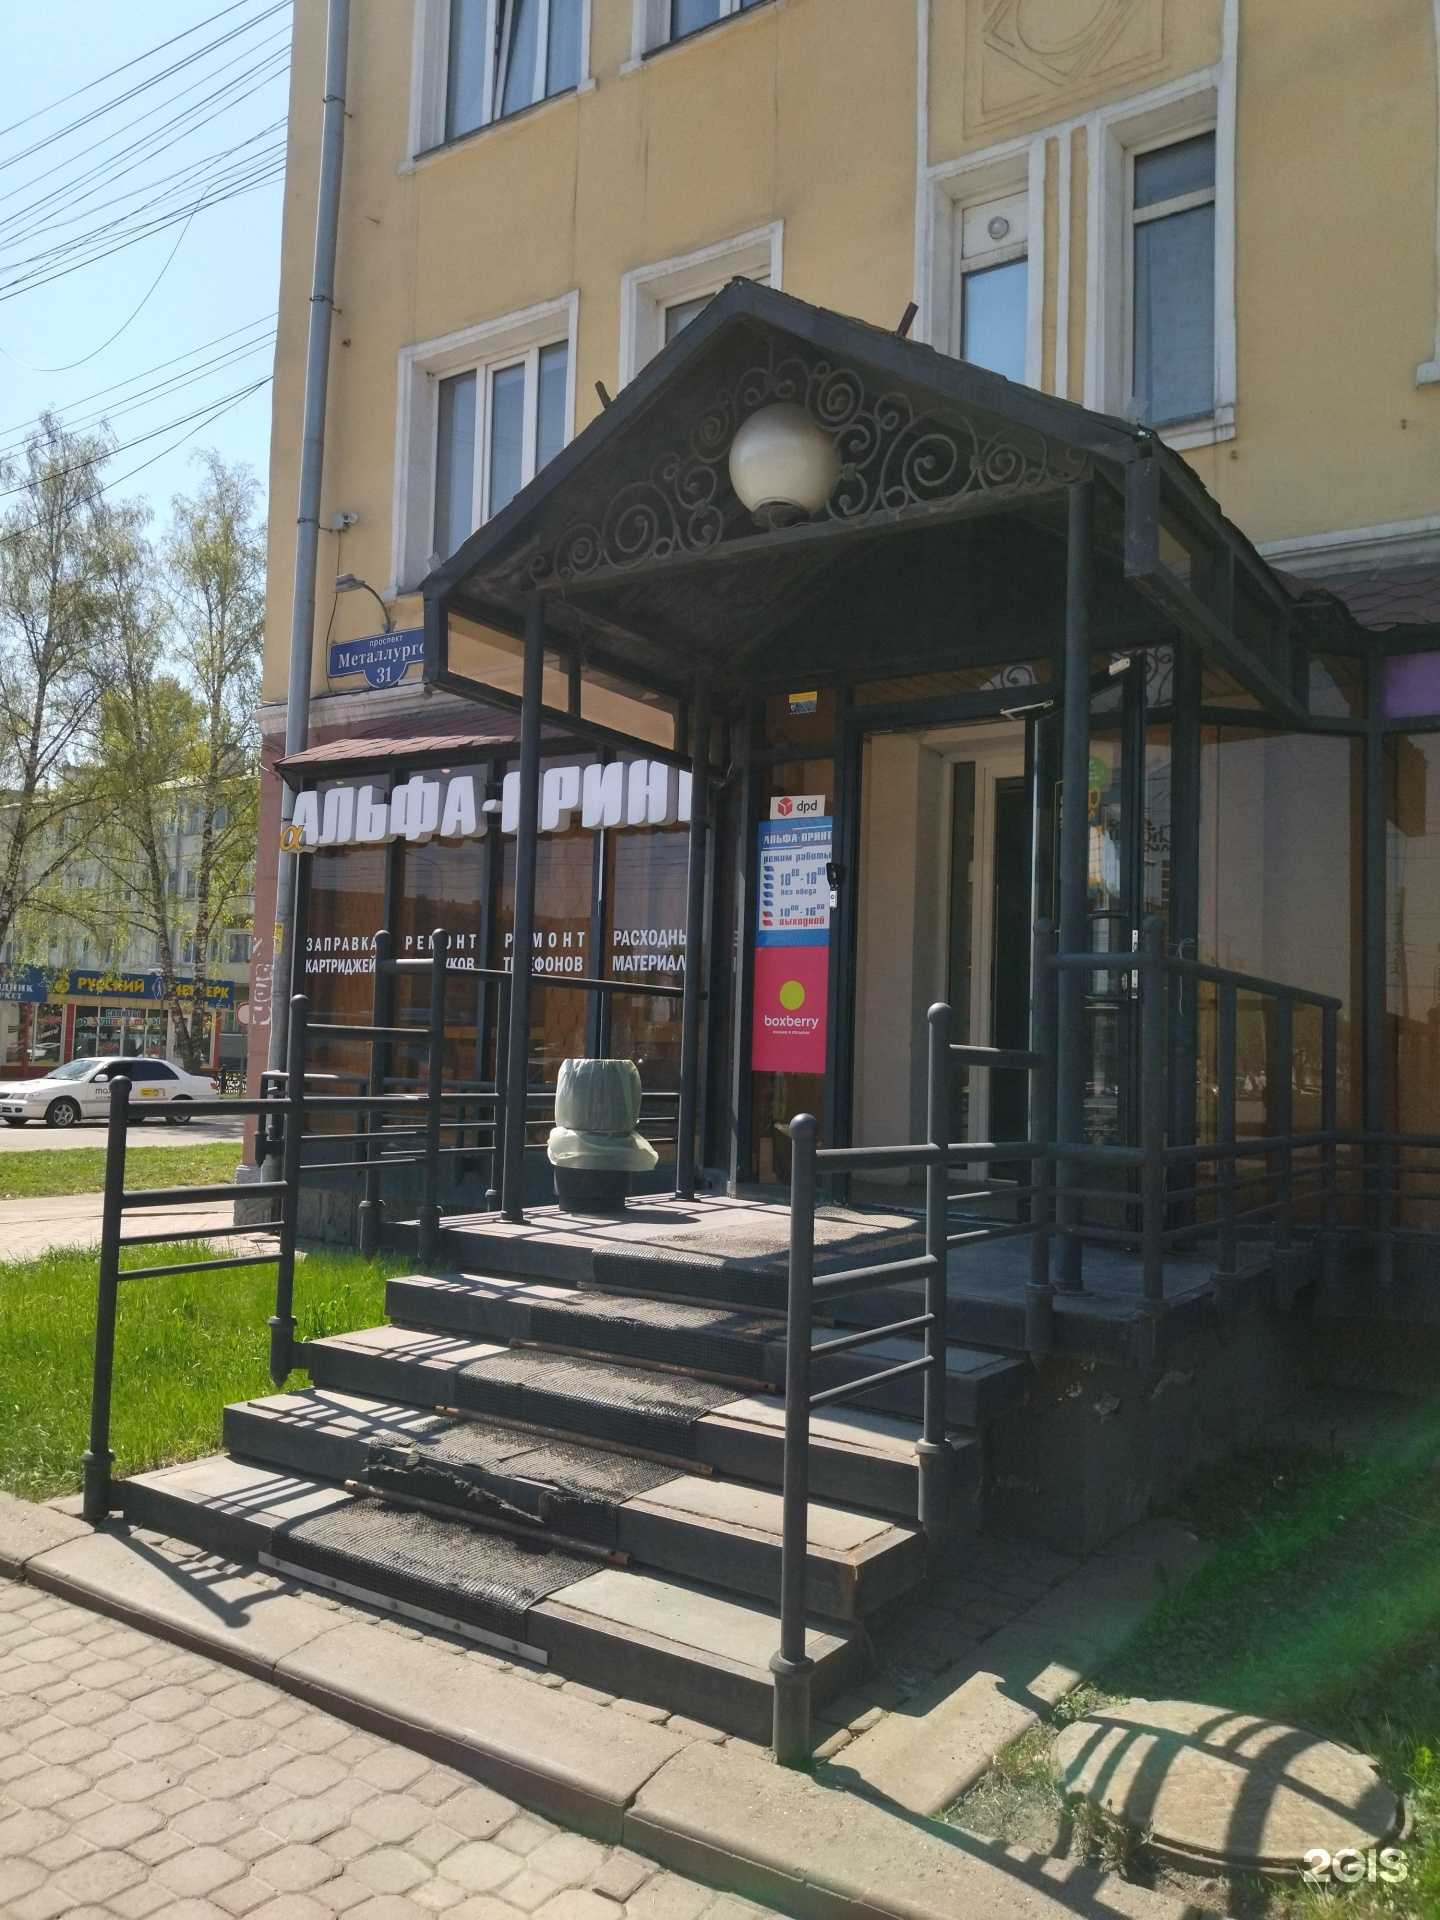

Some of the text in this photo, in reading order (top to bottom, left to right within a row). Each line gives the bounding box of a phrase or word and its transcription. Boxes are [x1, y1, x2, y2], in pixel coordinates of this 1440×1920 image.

[369, 634, 403, 647] проспект
[376, 666, 392, 683] 31
[796, 799, 818, 813] dpd
[306, 936, 376, 952] ЗАПРАВКА
[504, 931, 585, 948] РМОНТ
[613, 928, 686, 948] РАСХОДН
[305, 956, 376, 975] КАРТРИДЖЕЙ
[503, 955, 583, 972] ТФОНОВ
[612, 953, 686, 972] МАТЕРИАЛ
[77, 975, 145, 993] РУССКИЙ
[764, 1015, 819, 1030] boxberry
